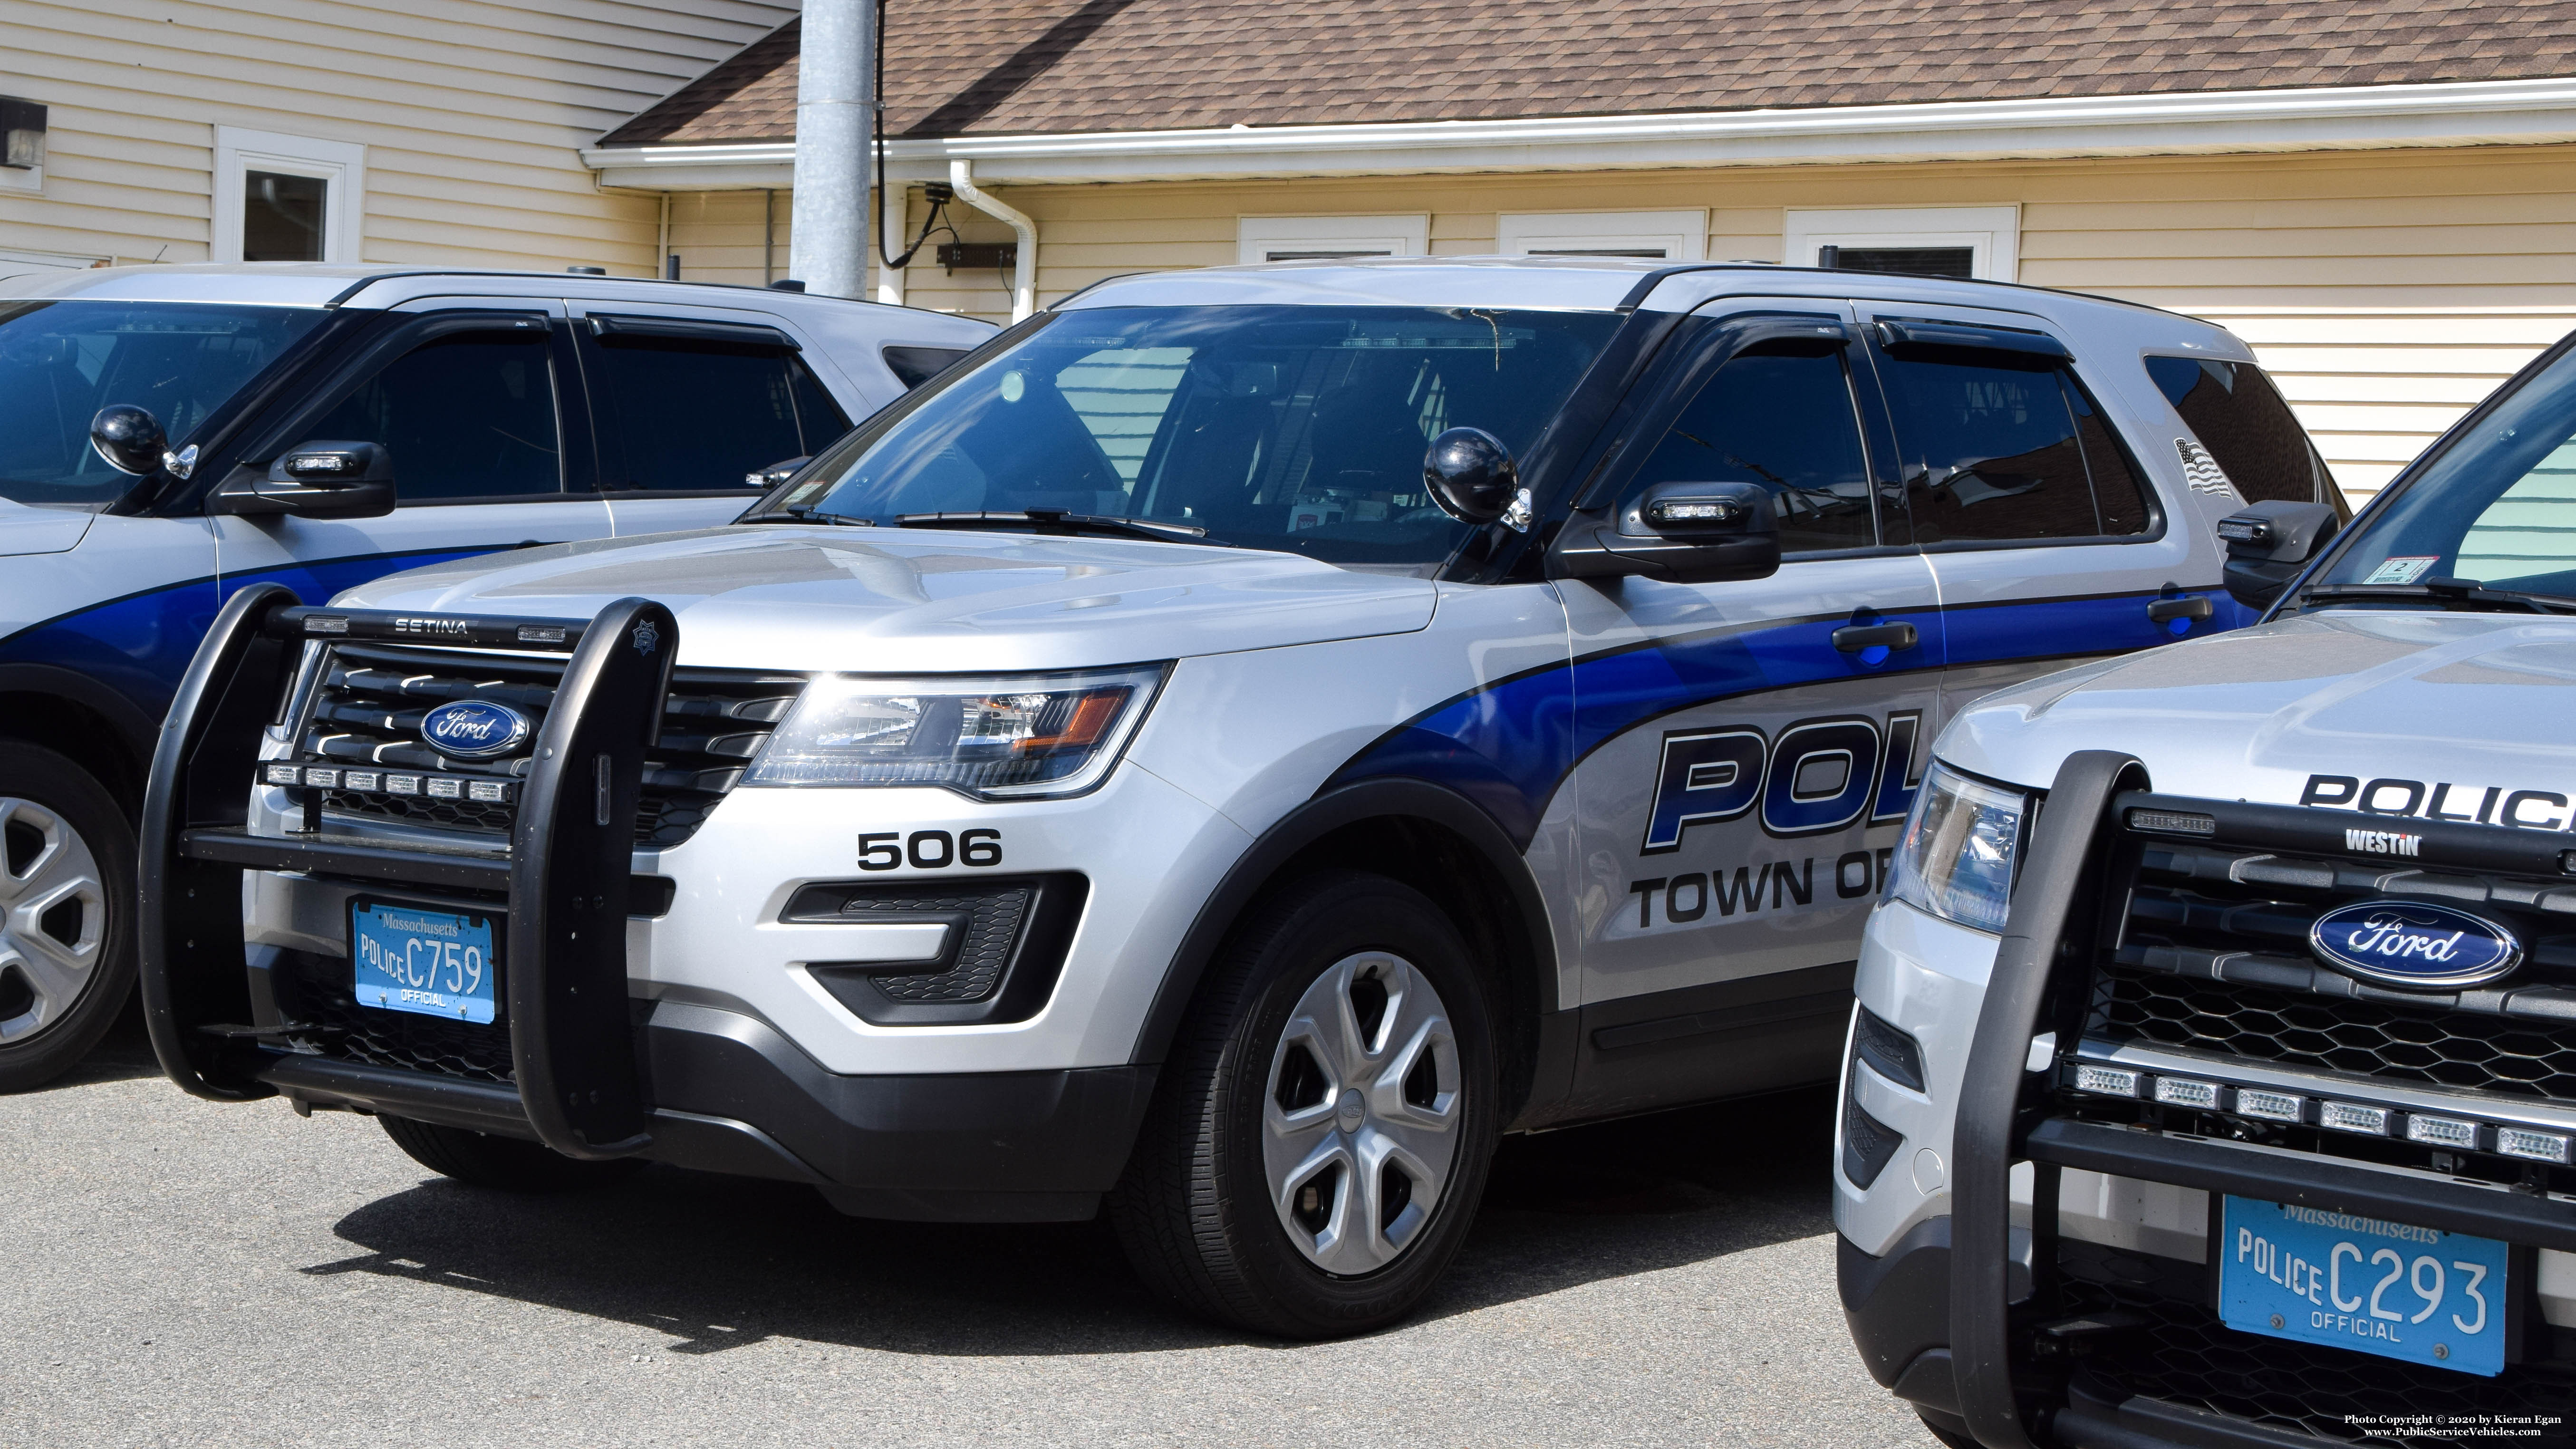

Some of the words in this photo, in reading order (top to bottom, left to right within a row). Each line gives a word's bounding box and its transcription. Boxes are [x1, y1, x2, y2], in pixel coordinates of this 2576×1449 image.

[2394, 562, 2408, 572] 2
[396, 618, 468, 634] SETINA
[436, 707, 497, 741] Ford
[2298, 774, 2576, 832] POLIC
[858, 828, 1003, 871] 506
[1630, 858, 1814, 928] TOWN
[383, 912, 458, 937] Massachusetts
[2348, 912, 2465, 962] Ford
[361, 933, 405, 985] POLICE
[406, 937, 482, 995] C759
[401, 988, 446, 1008] OFFICIAL
[2284, 1204, 2439, 1245] Massachusetts
[2238, 1226, 2323, 1306] POLICE
[2330, 1241, 2488, 1335] C293
[2310, 1310, 2402, 1343] OFFICIAL
